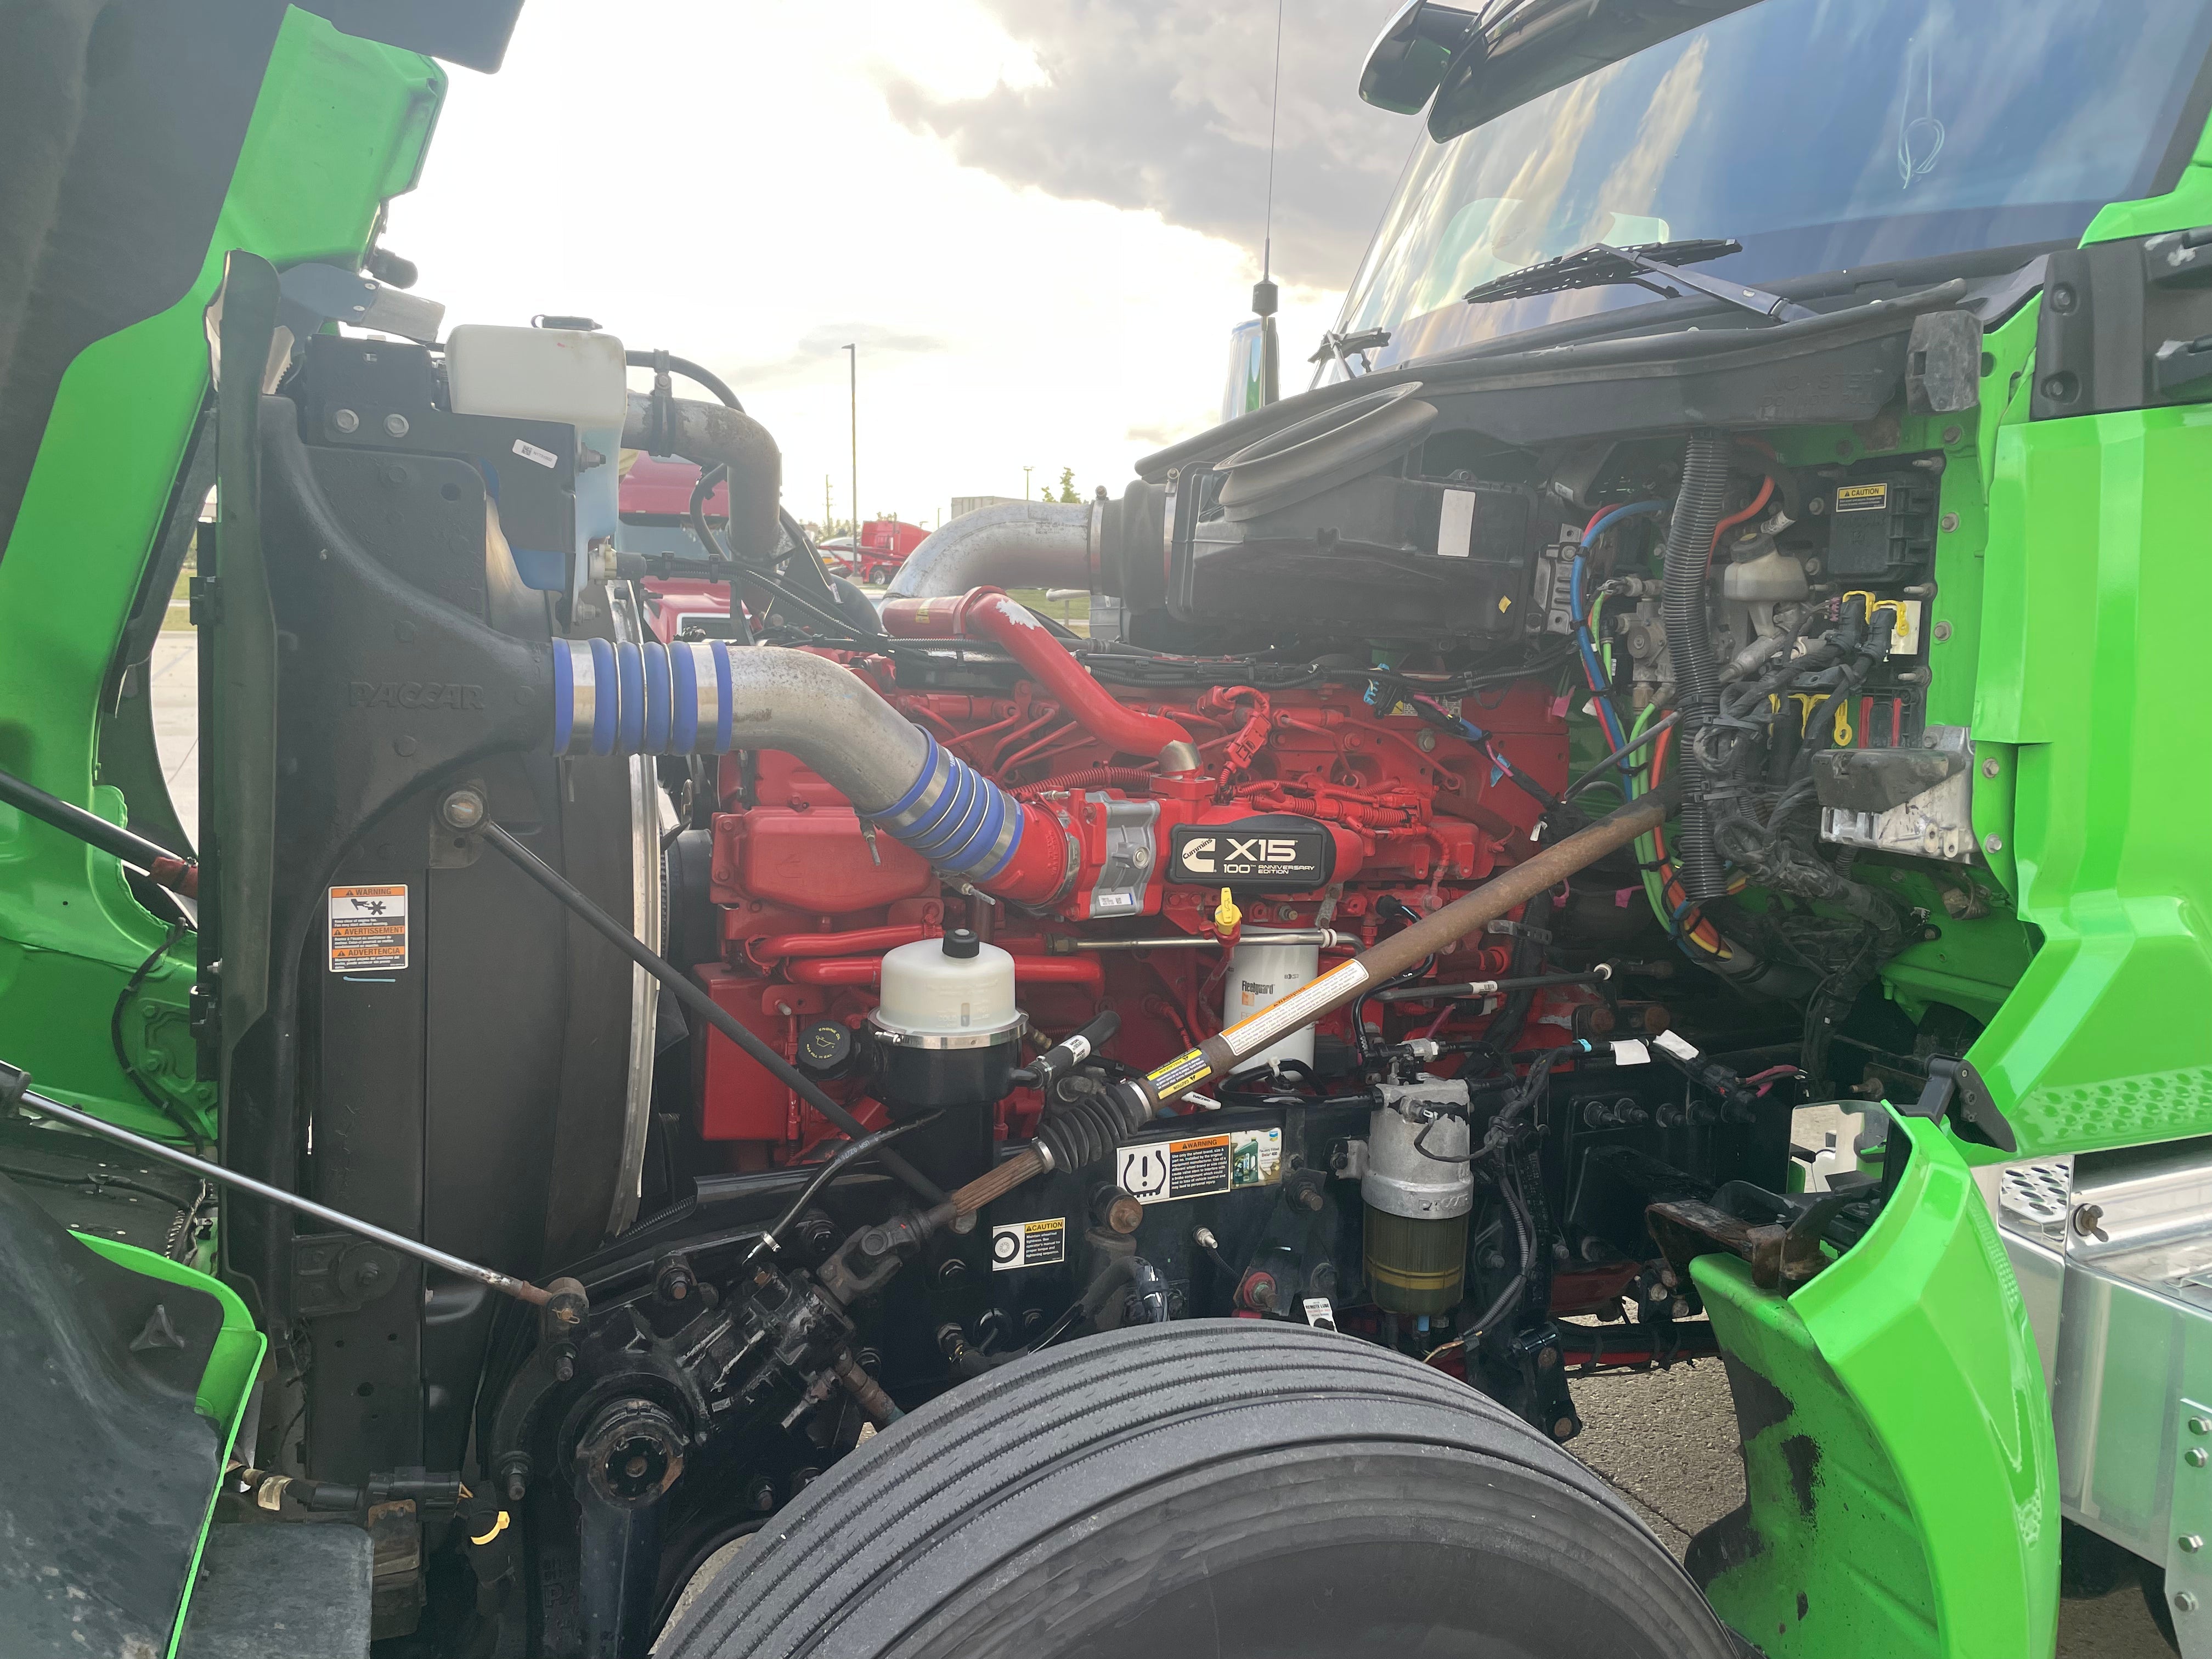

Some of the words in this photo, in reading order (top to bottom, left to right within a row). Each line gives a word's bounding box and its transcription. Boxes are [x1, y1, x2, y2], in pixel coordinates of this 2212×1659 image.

[1851, 488, 1879, 496] CAUTION
[349, 681, 485, 709] PACCAR
[1183, 838, 1212, 859] Cummins
[1224, 838, 1296, 861] X15
[344, 926, 403, 935] AVERTISSEMENT
[348, 947, 400, 956] ADVERTENCIA
[1242, 980, 1273, 995] Fleetguard
[1173, 1079, 1189, 1091] CAUTION
[1188, 1139, 1217, 1148] WARNING
[1032, 1222, 1063, 1231] CAUTION
